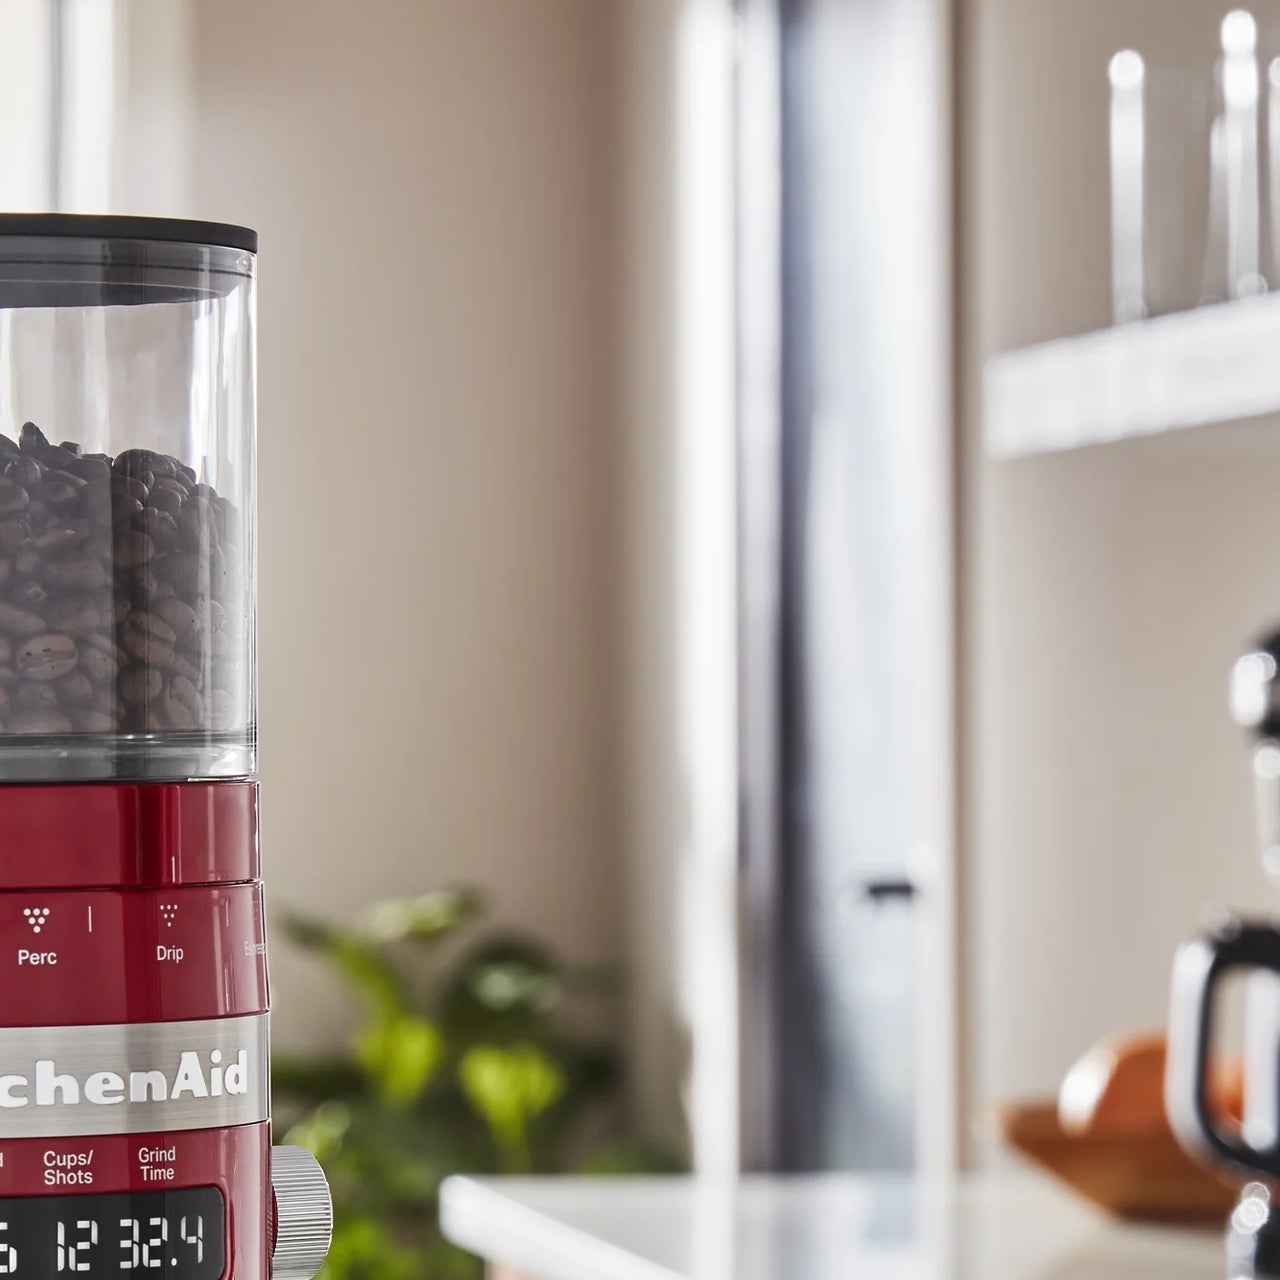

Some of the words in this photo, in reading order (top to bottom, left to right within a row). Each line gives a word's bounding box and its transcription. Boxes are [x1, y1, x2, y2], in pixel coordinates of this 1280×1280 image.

[18, 949, 58, 966] Perc
[156, 945, 184, 964] Drip
[43, 1149, 94, 1168] Cups/
[138, 1147, 176, 1164] Grind
[44, 1169, 93, 1185] Shots
[140, 1166, 175, 1182] Time
[57, 1220, 99, 1272] 12
[119, 1214, 203, 1269] 32.4
